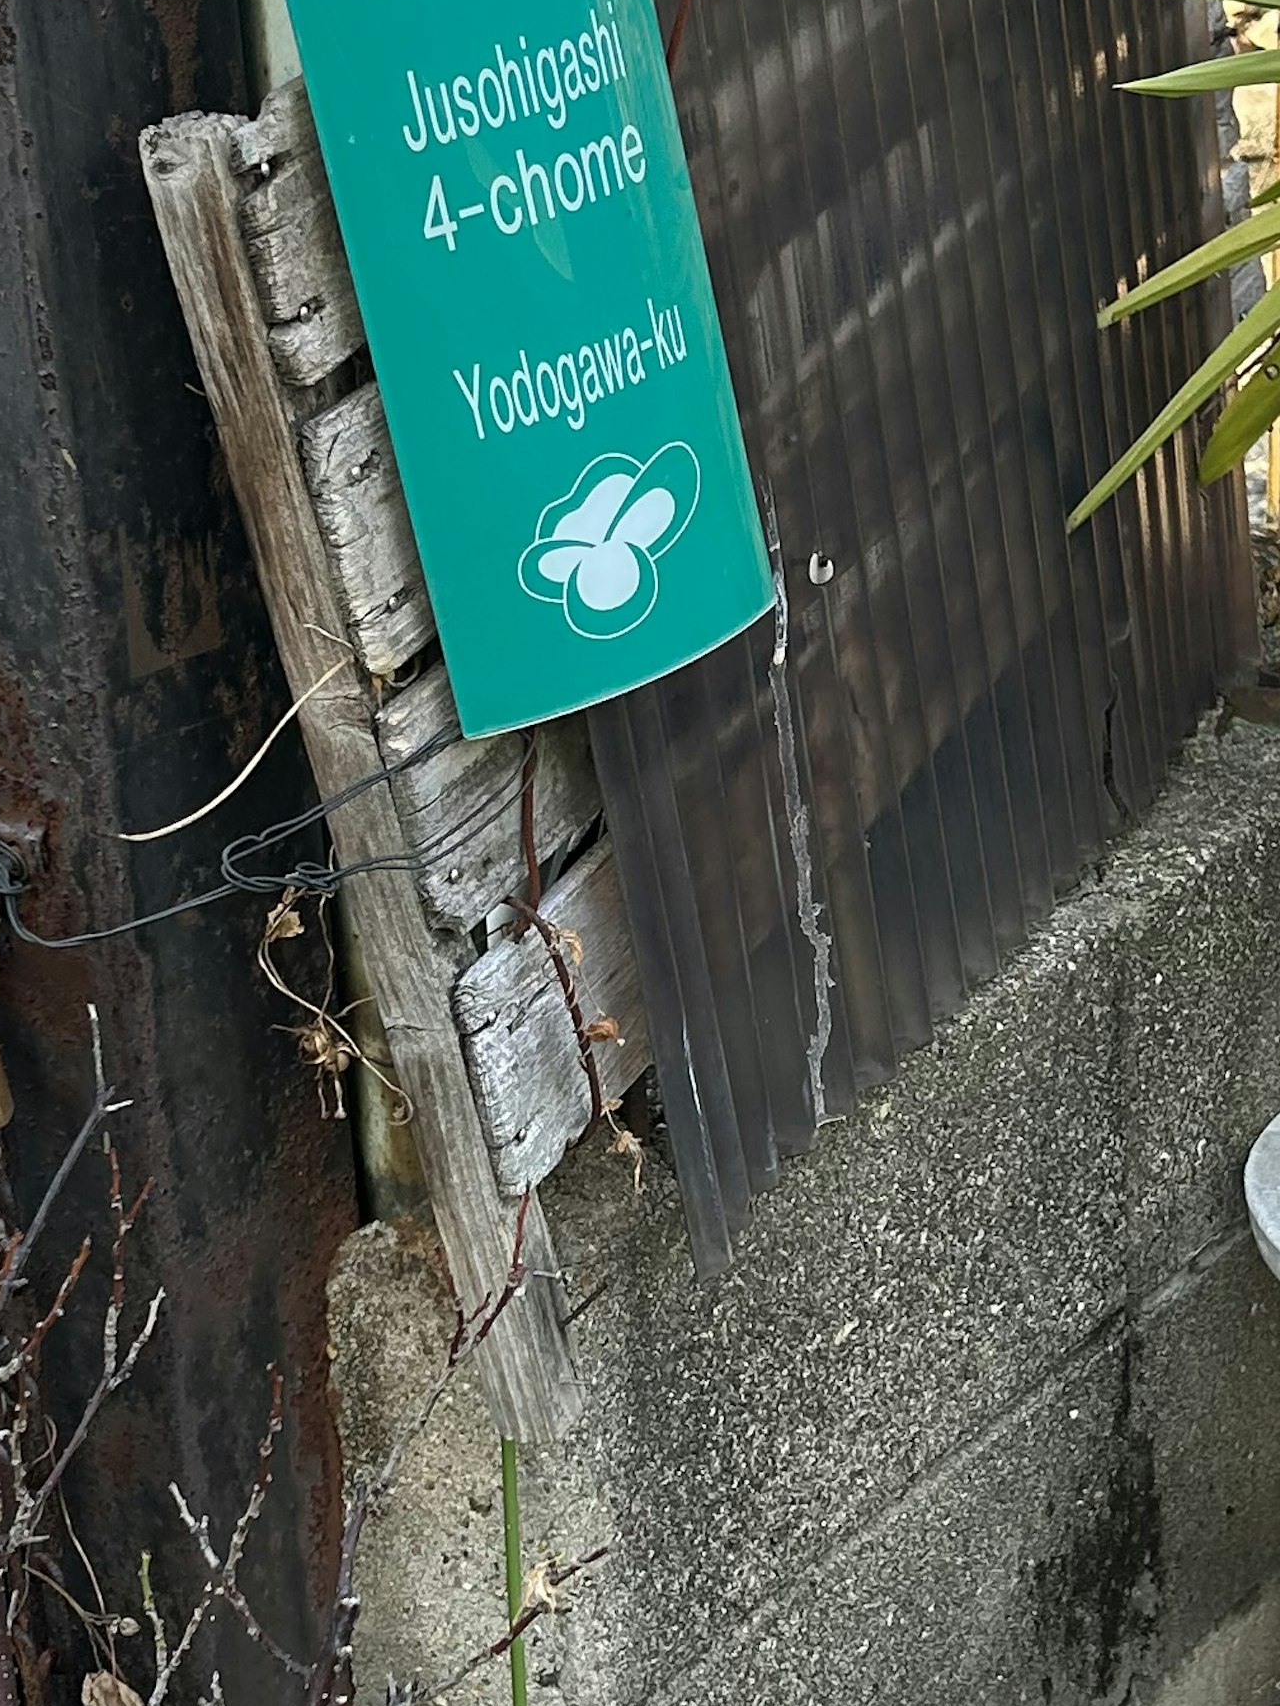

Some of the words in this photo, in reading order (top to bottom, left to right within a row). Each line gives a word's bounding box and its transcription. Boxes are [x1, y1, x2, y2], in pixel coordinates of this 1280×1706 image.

[402, 2, 627, 154] Jusohigashi
[422, 118, 648, 252] 4-chome
[453, 297, 689, 442] Yodogawa-ku
